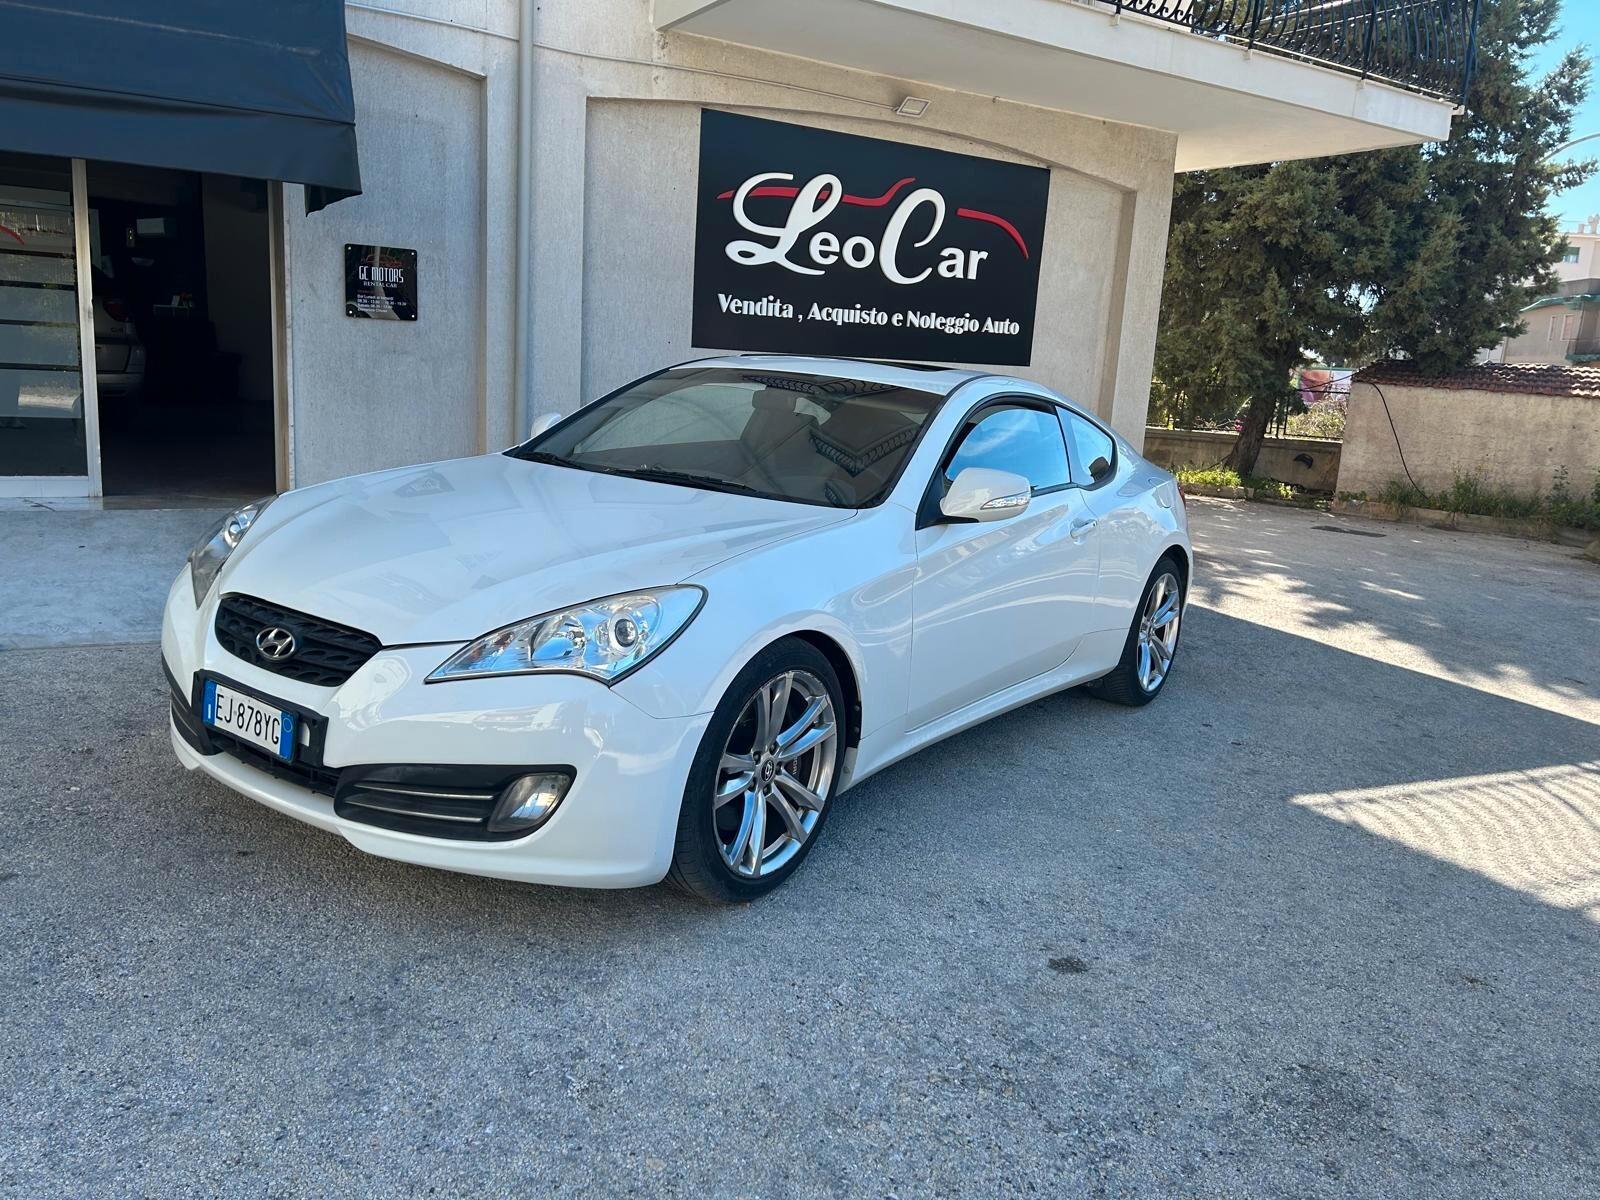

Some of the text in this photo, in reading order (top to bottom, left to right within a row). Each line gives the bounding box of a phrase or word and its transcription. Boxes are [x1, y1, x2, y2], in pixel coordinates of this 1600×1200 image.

[359, 266, 404, 283] GC MOTORS
[717, 293, 794, 319] Vendita
[807, 302, 888, 327] Acquisto
[891, 313, 903, 327] e
[906, 310, 979, 335] Noleggio
[981, 316, 1020, 335] Auto
